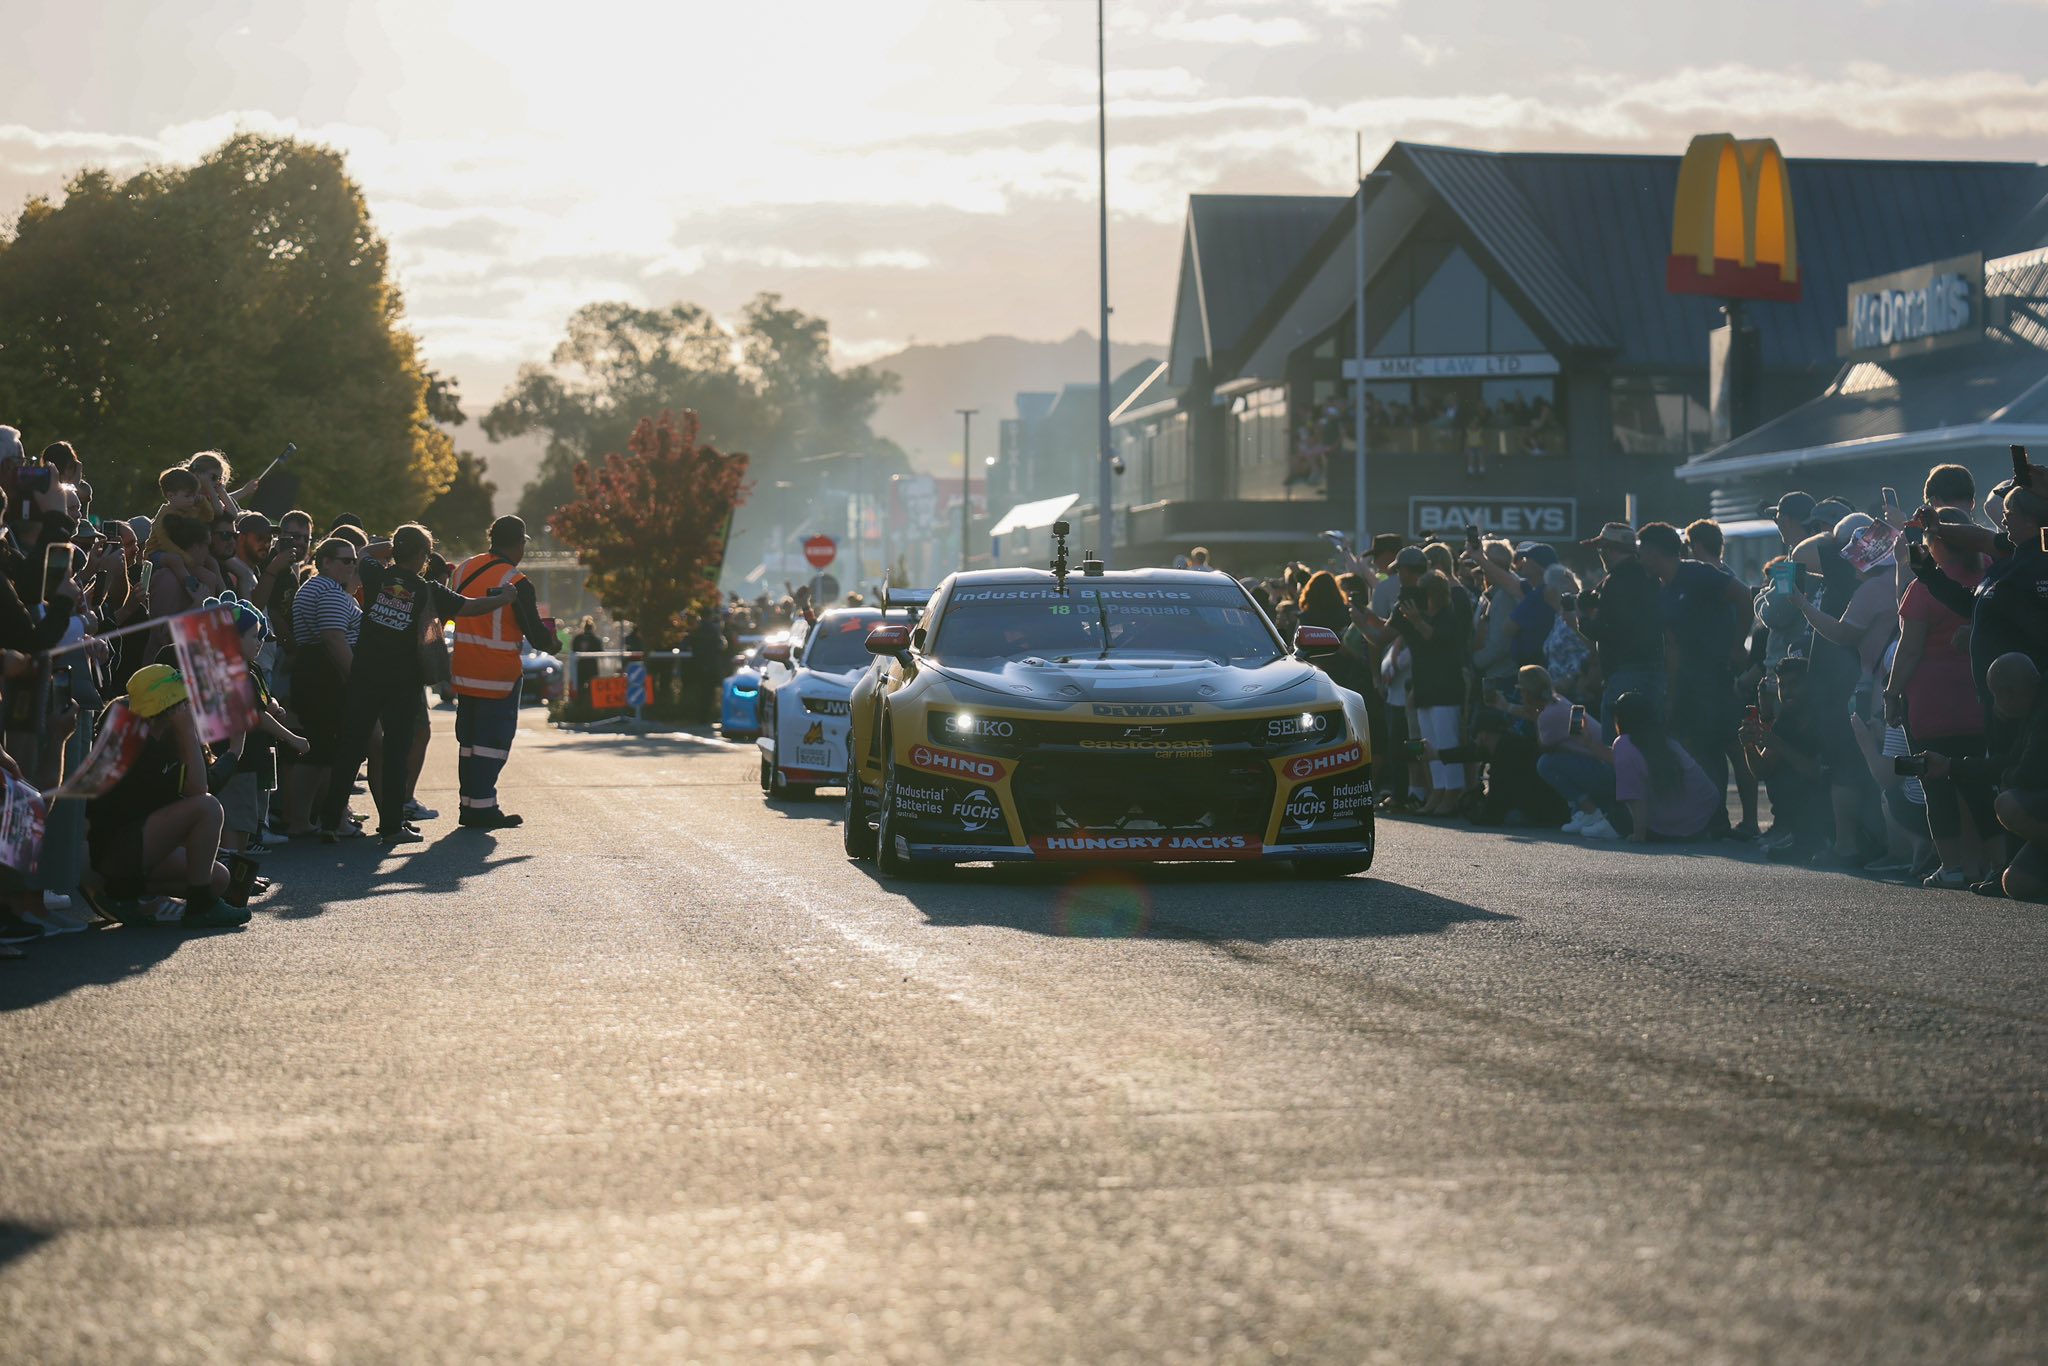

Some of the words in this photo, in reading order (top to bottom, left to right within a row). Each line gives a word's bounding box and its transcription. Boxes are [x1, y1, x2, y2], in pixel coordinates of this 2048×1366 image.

[1379, 358, 1424, 374] MMC
[1434, 357, 1475, 373] LAW
[1486, 356, 1521, 373] LTD
[1420, 506, 1565, 531] BAYLEYS
[954, 590, 1070, 601] Industrial
[1081, 590, 1191, 600] Batteries
[371, 603, 413, 622] AMPOL
[1049, 605, 1071, 615] 18
[1108, 605, 1190, 616] Pasquale
[368, 611, 410, 629] RACING
[1080, 738, 1213, 749] eastcoast
[1155, 750, 1174, 759] car
[1175, 749, 1213, 758] rentals
[1314, 748, 1359, 770] HINO
[933, 754, 994, 776] HINO
[896, 784, 944, 801] Industrial
[1333, 780, 1373, 796] Industrial
[896, 799, 943, 814] Batteries
[1285, 801, 1326, 816] FUCHS
[1333, 796, 1372, 810] Batteries
[952, 803, 1000, 820] FUCHS
[1047, 837, 1162, 849] HUNGRY
[1169, 836, 1246, 848] JACK'S
